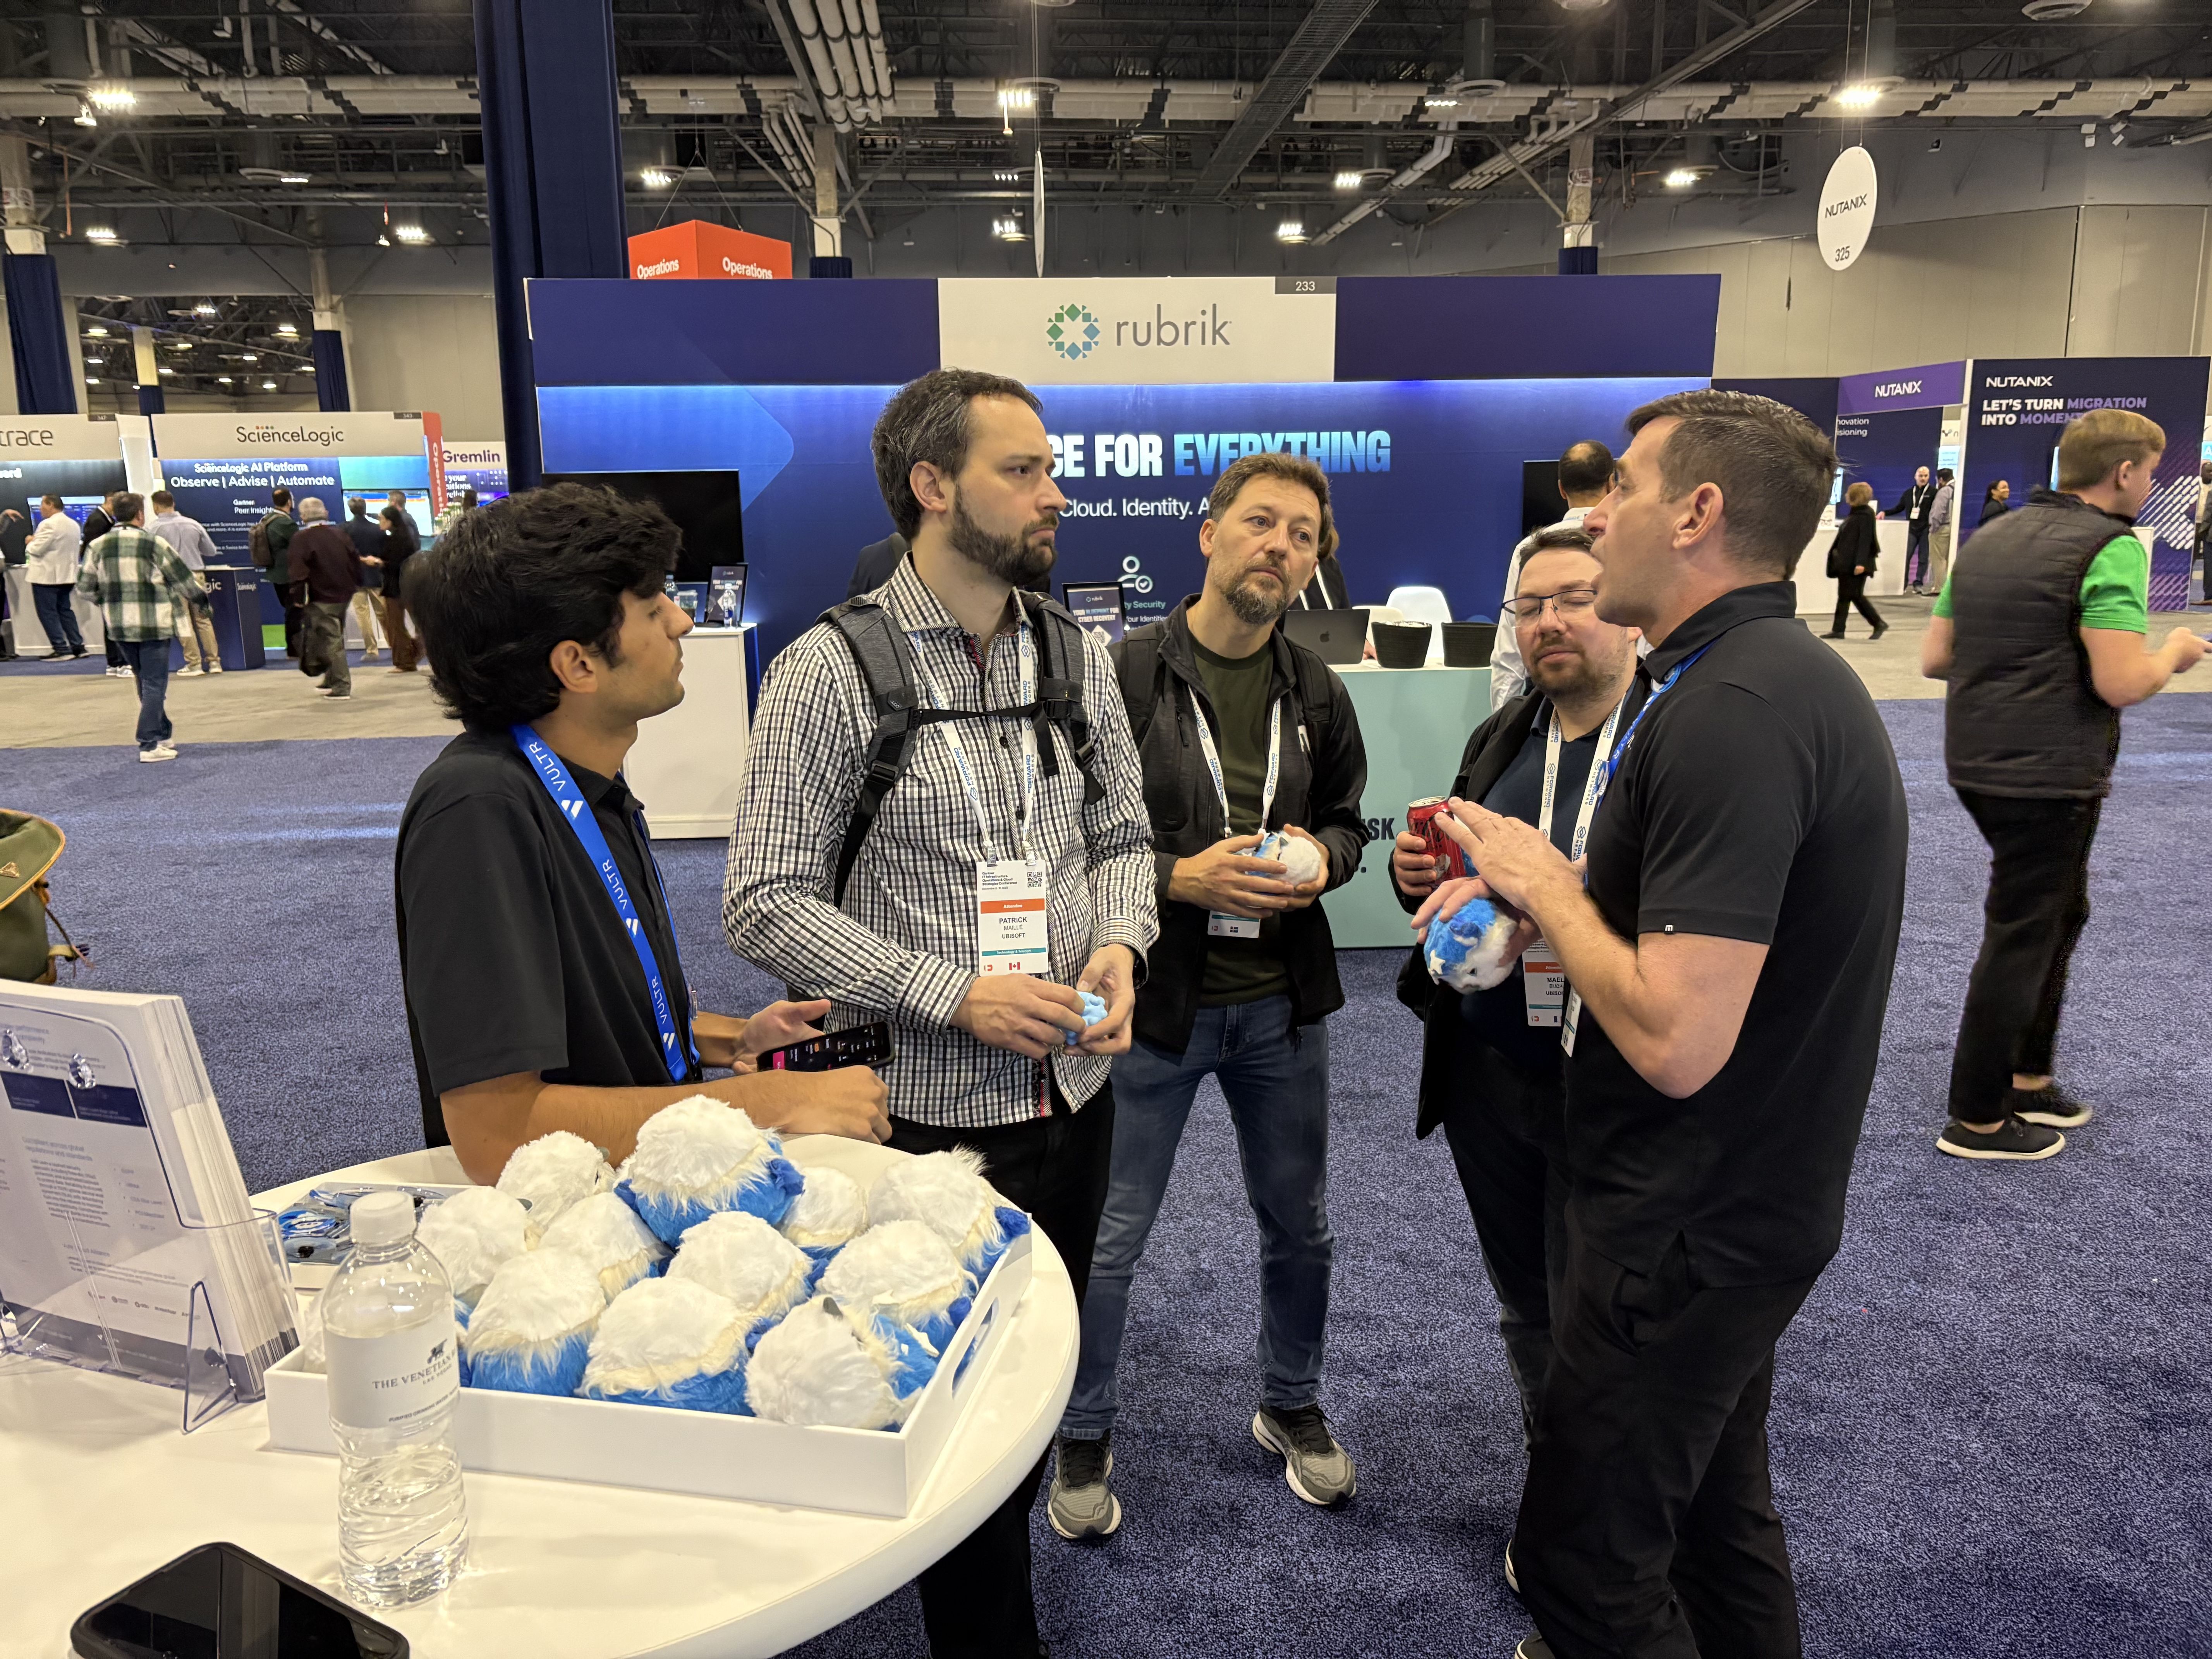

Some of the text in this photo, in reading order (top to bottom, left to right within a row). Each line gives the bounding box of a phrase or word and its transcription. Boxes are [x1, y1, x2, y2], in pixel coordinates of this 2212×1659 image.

[1824, 193, 1867, 218] NUTANIX
[1835, 246, 1850, 262] 325
[637, 258, 680, 279] Operations
[722, 257, 773, 279] Operations
[1295, 281, 1316, 292] 233
[1116, 303, 1230, 347] rubrik
[1875, 380, 1922, 398] NUTANIX
[1986, 376, 2054, 388] NUTANIX
[1982, 397, 2148, 411] LET'S TURN MIGRATION
[1981, 413, 2017, 426] INTO
[236, 426, 344, 447] ScienceLogic
[443, 449, 500, 463] Gremlin
[1094, 433, 1163, 477] FOR
[251, 462, 263, 472] AI
[264, 461, 309, 472] Platform
[170, 476, 220, 488] Observe
[228, 476, 268, 487] Advise
[276, 474, 335, 486] Automate
[1059, 498, 1117, 517] Cloud.
[1122, 498, 1194, 520] Identity.
[1133, 600, 1166, 610] Security
[529, 741, 566, 792] VULTR
[954, 747, 972, 786] FORWARD
[1575, 840, 1583, 861] FORW
[602, 859, 627, 910] VULTR
[651, 975, 667, 1024] VULTR
[372, 1354, 451, 1389] THE VENETIAN
